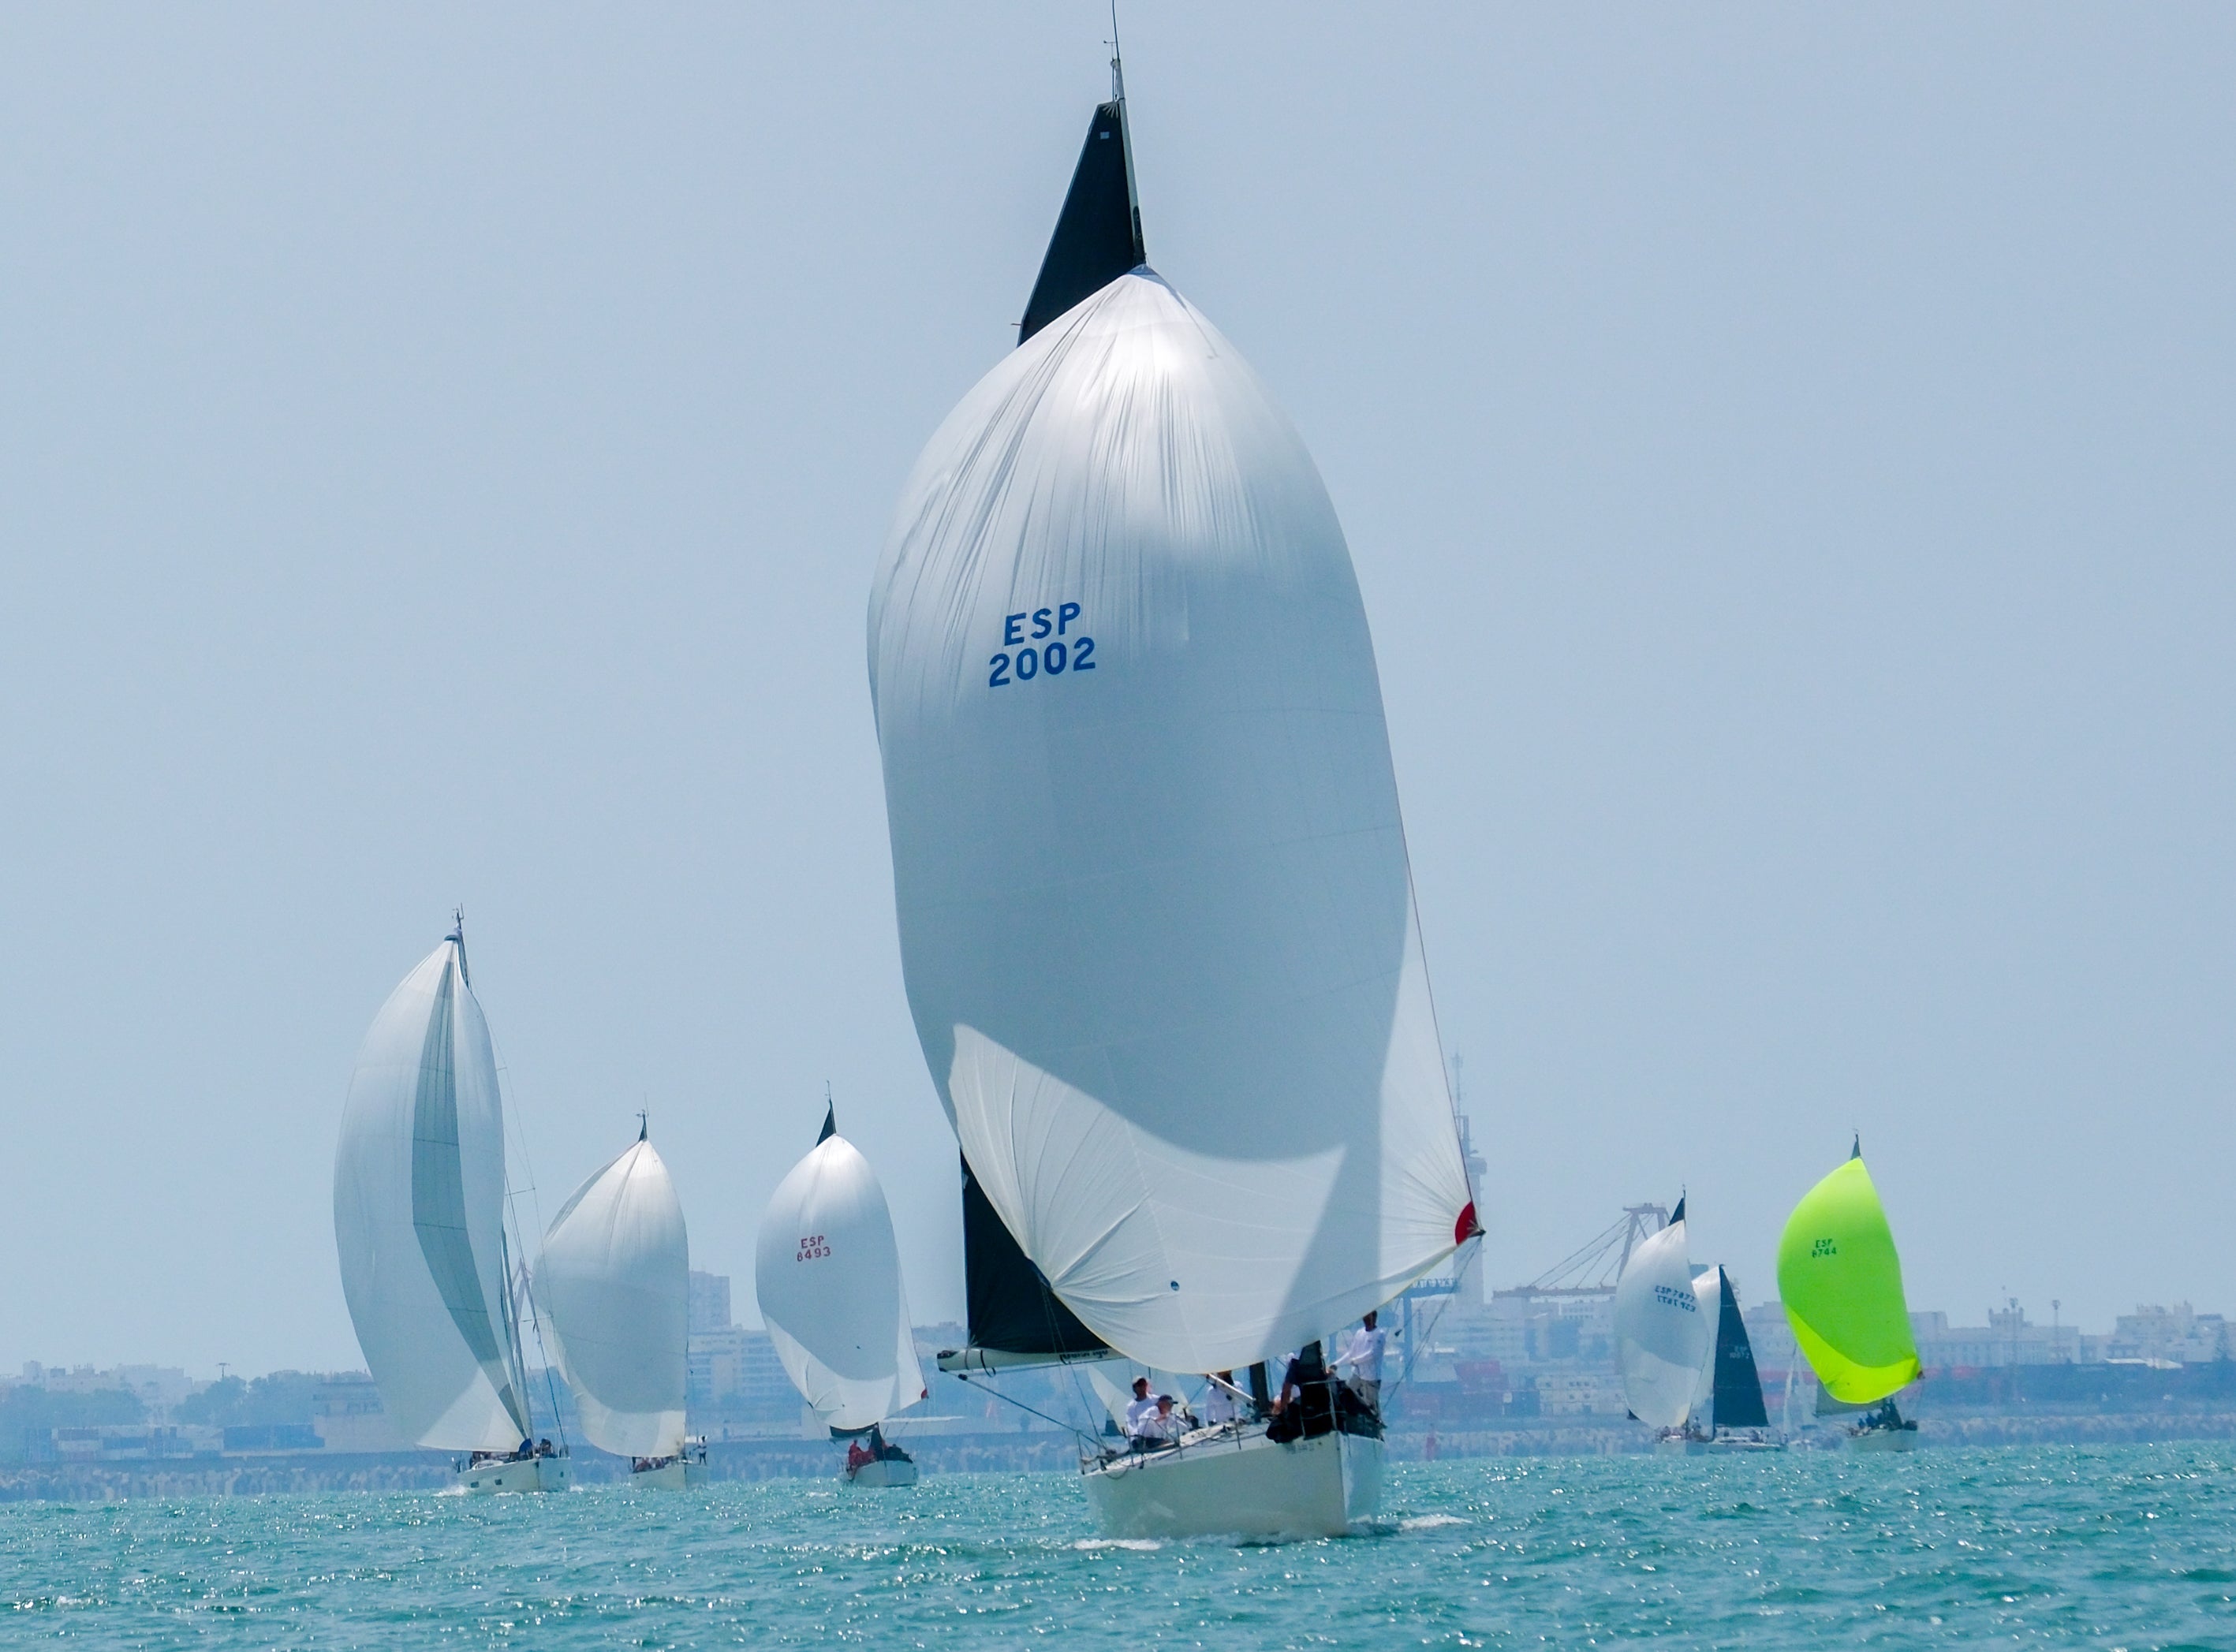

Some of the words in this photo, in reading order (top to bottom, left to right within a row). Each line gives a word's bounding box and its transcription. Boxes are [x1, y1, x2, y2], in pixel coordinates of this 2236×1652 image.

[1004, 602, 1081, 647] ESP
[989, 636, 1096, 688] 2002
[801, 1235, 824, 1249] ESP
[1816, 1238, 1833, 1248] ESP
[1655, 1285, 1671, 1295] ESP
